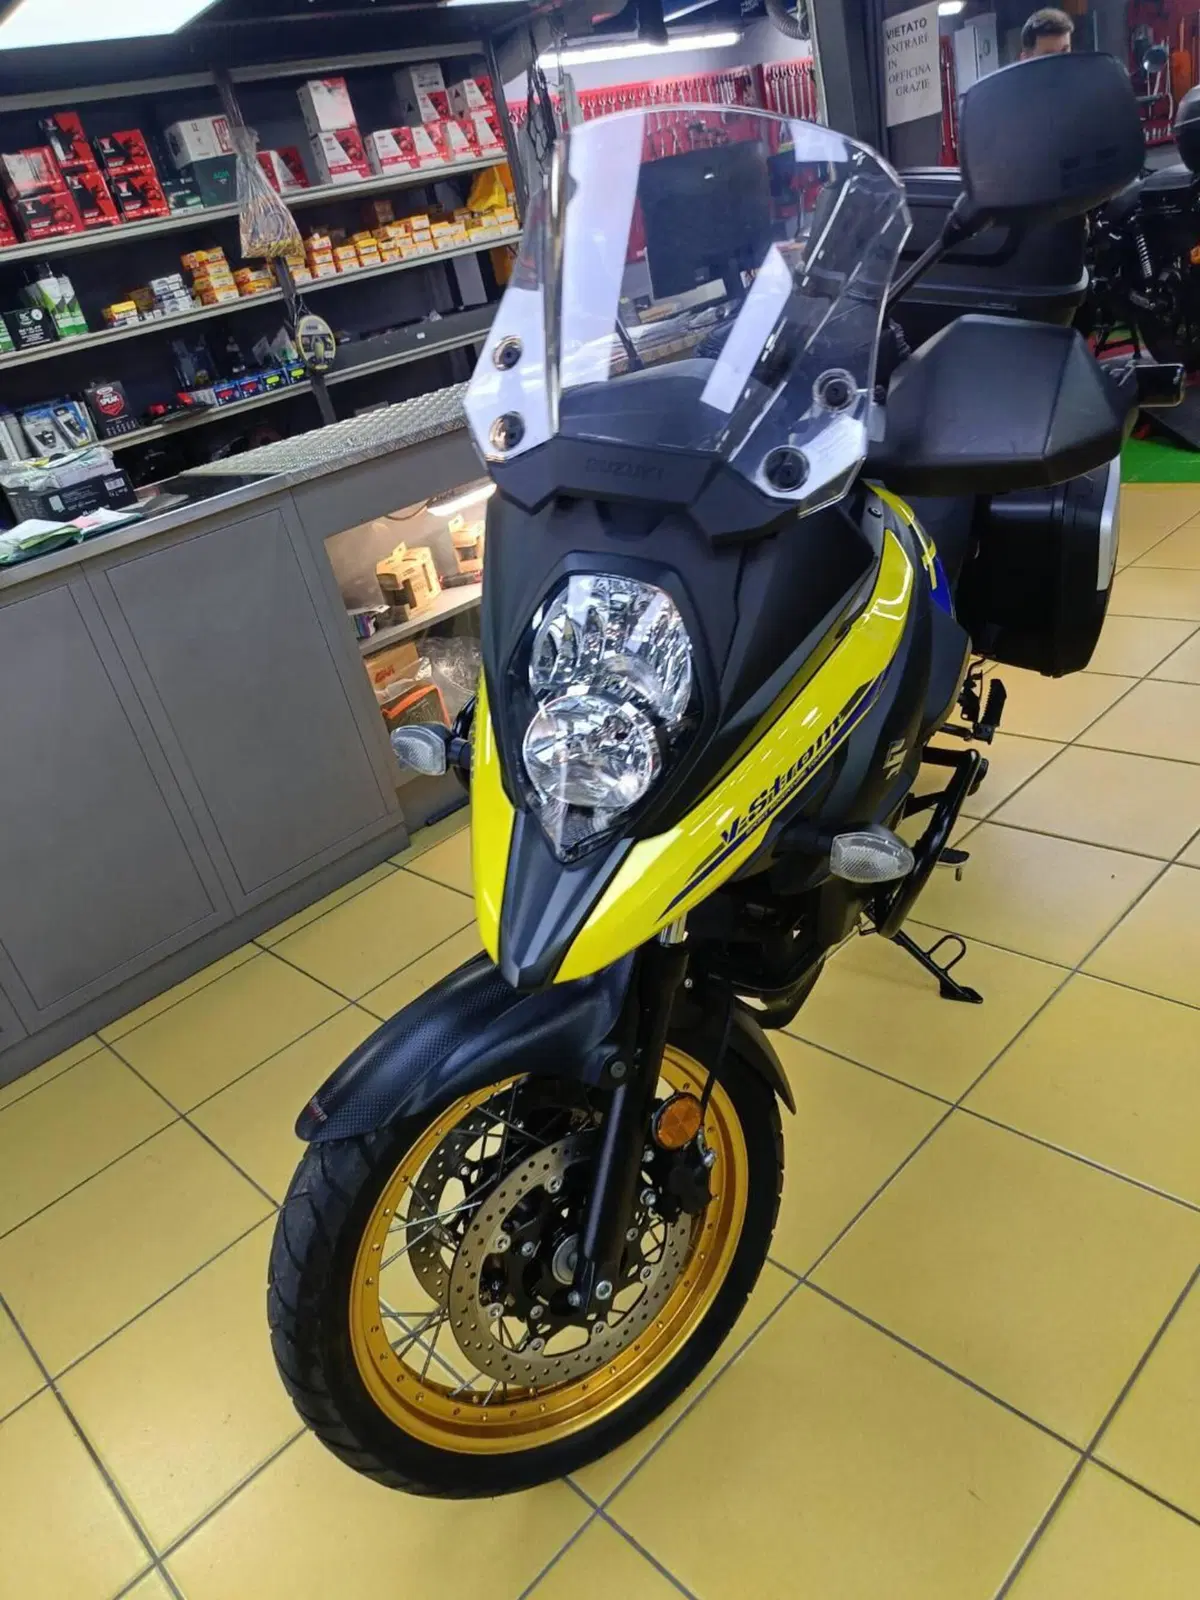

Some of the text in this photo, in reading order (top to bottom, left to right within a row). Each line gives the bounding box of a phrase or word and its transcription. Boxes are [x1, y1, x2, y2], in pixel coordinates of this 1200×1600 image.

[886, 18, 927, 40] VIETATO
[887, 32, 928, 55] ENTRARE
[888, 59, 898, 70] IN
[888, 64, 931, 83] OFFICINA
[895, 78, 930, 96] GRAZIE
[584, 457, 665, 480] SUZUKI
[720, 714, 843, 843] V-Strom
